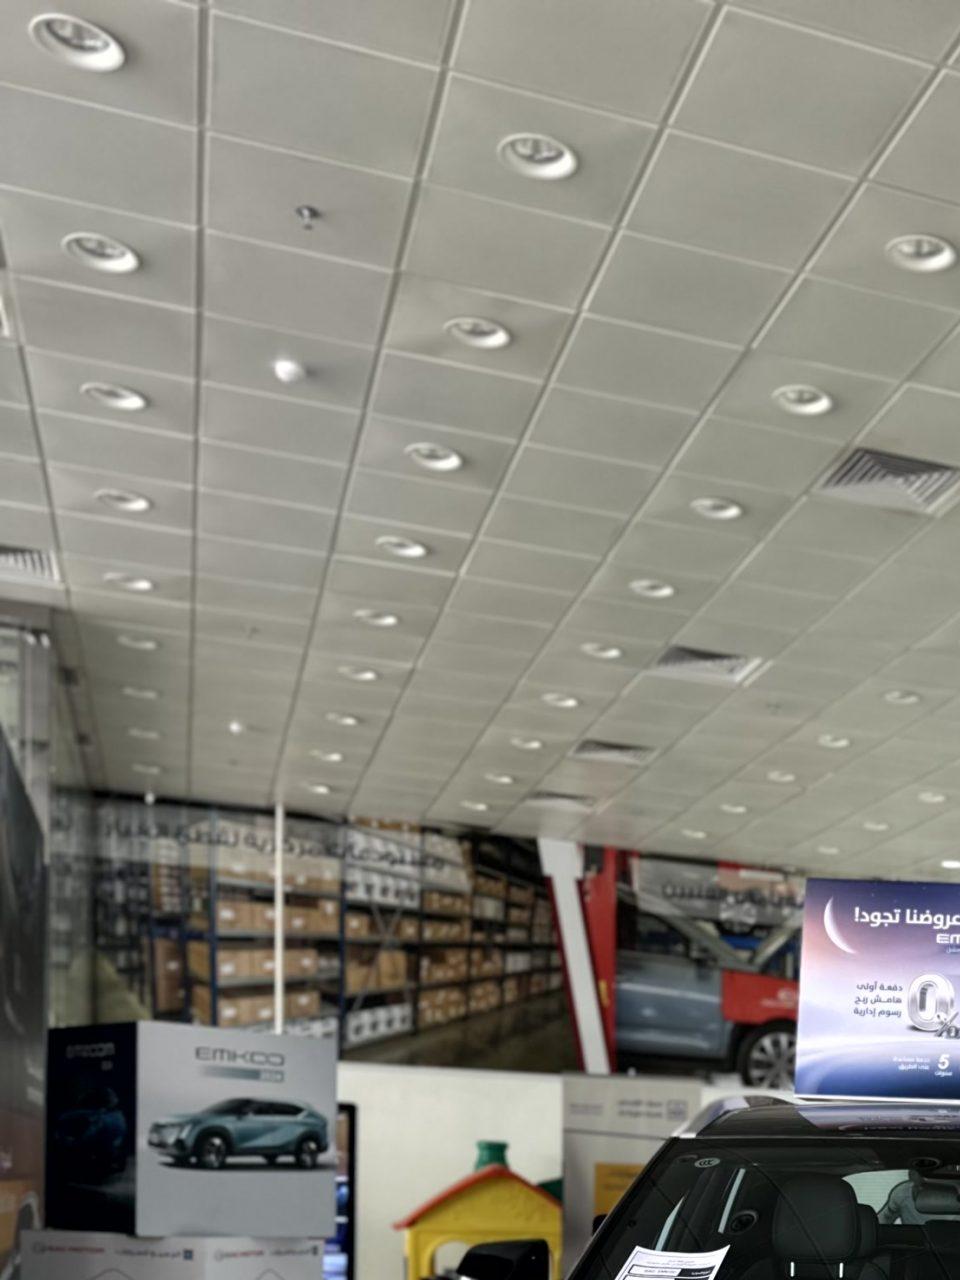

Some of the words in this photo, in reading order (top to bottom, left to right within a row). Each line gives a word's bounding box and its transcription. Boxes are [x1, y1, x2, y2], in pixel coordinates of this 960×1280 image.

[853, 906, 901, 928] تجود!
[195, 1045, 286, 1067] EMKOO
[937, 1054, 950, 1070] 5
